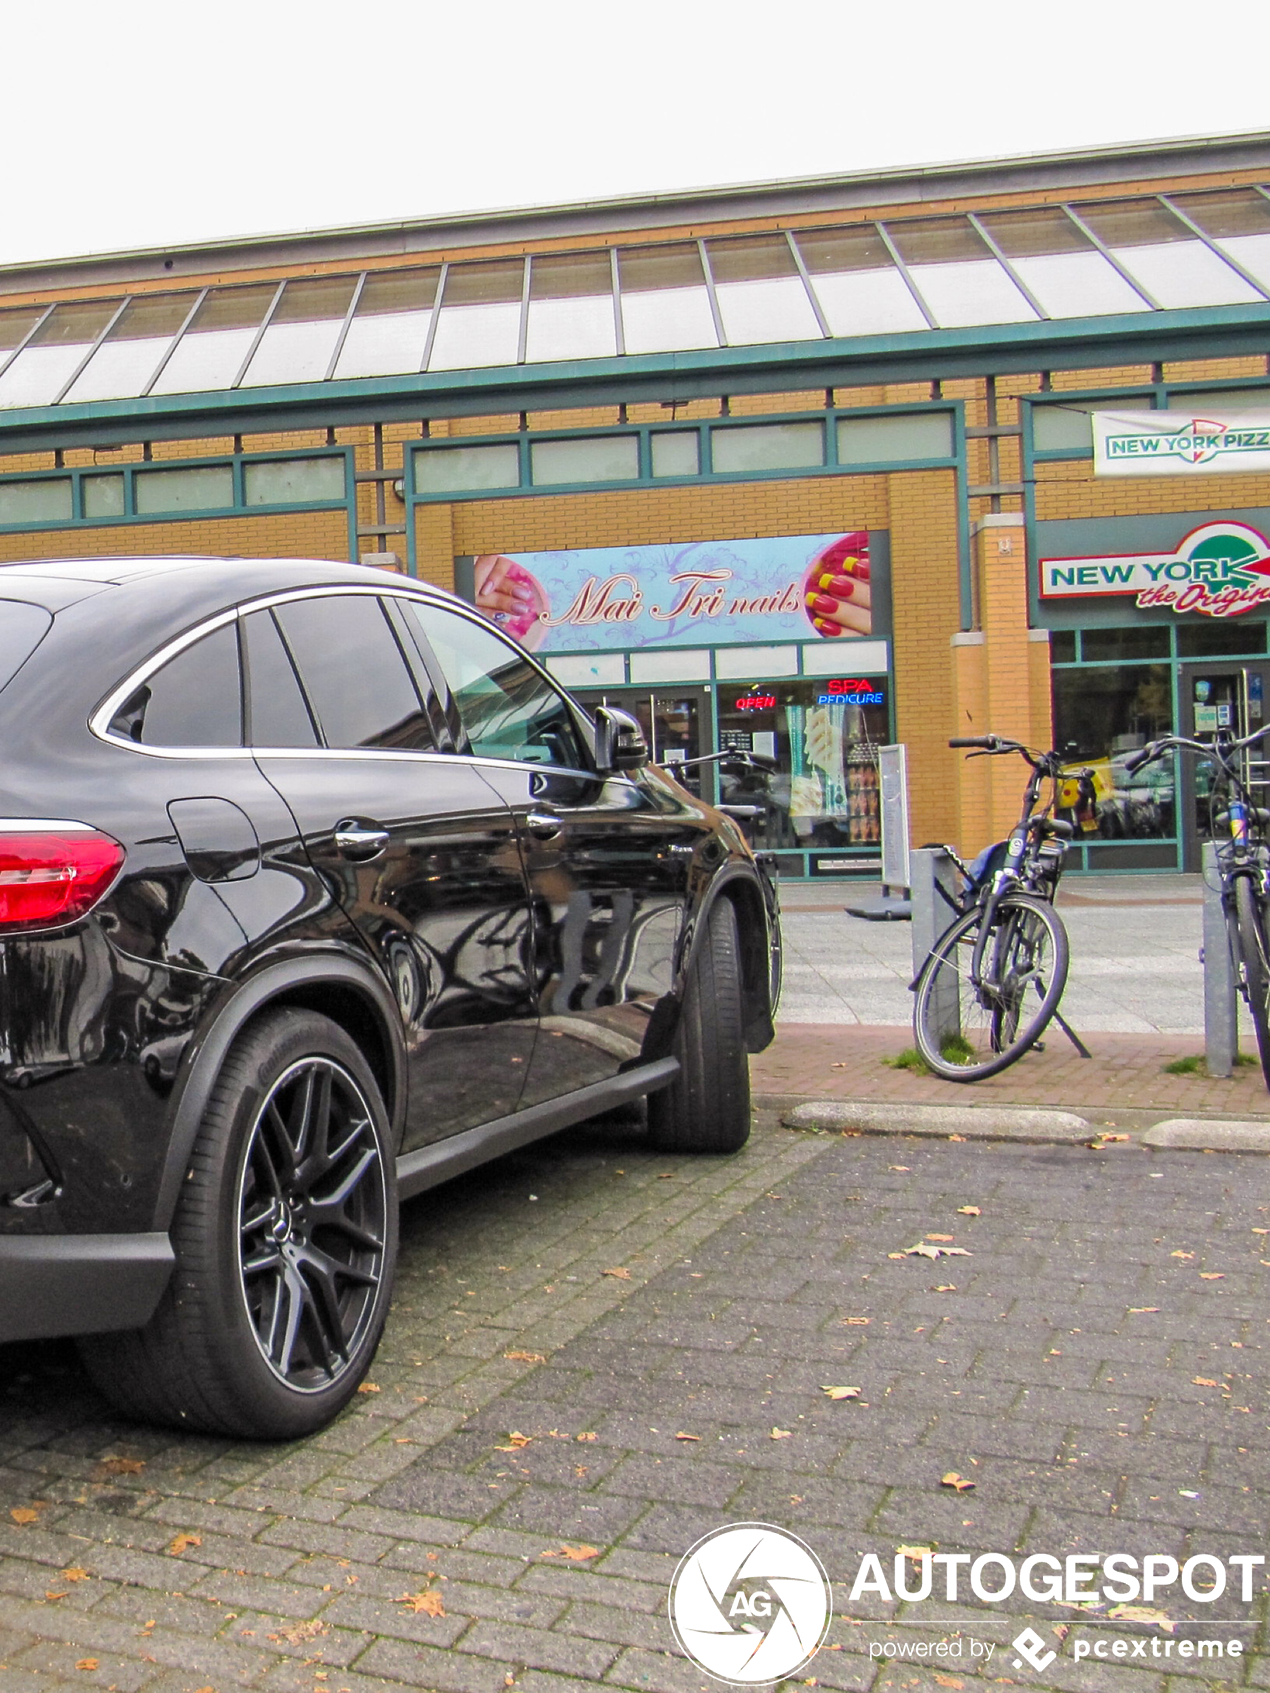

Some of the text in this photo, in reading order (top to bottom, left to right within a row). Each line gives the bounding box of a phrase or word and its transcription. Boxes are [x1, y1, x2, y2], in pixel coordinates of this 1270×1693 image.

[1112, 438, 1160, 454] NEW
[1165, 435, 1221, 450] YORK
[1051, 552, 1260, 587] NEW YORK
[539, 568, 801, 627] Mai Tri nails
[1138, 584, 1178, 606] the
[828, 679, 874, 695] SPA
[736, 696, 776, 709] OPEN
[818, 693, 883, 705] PEDICURE
